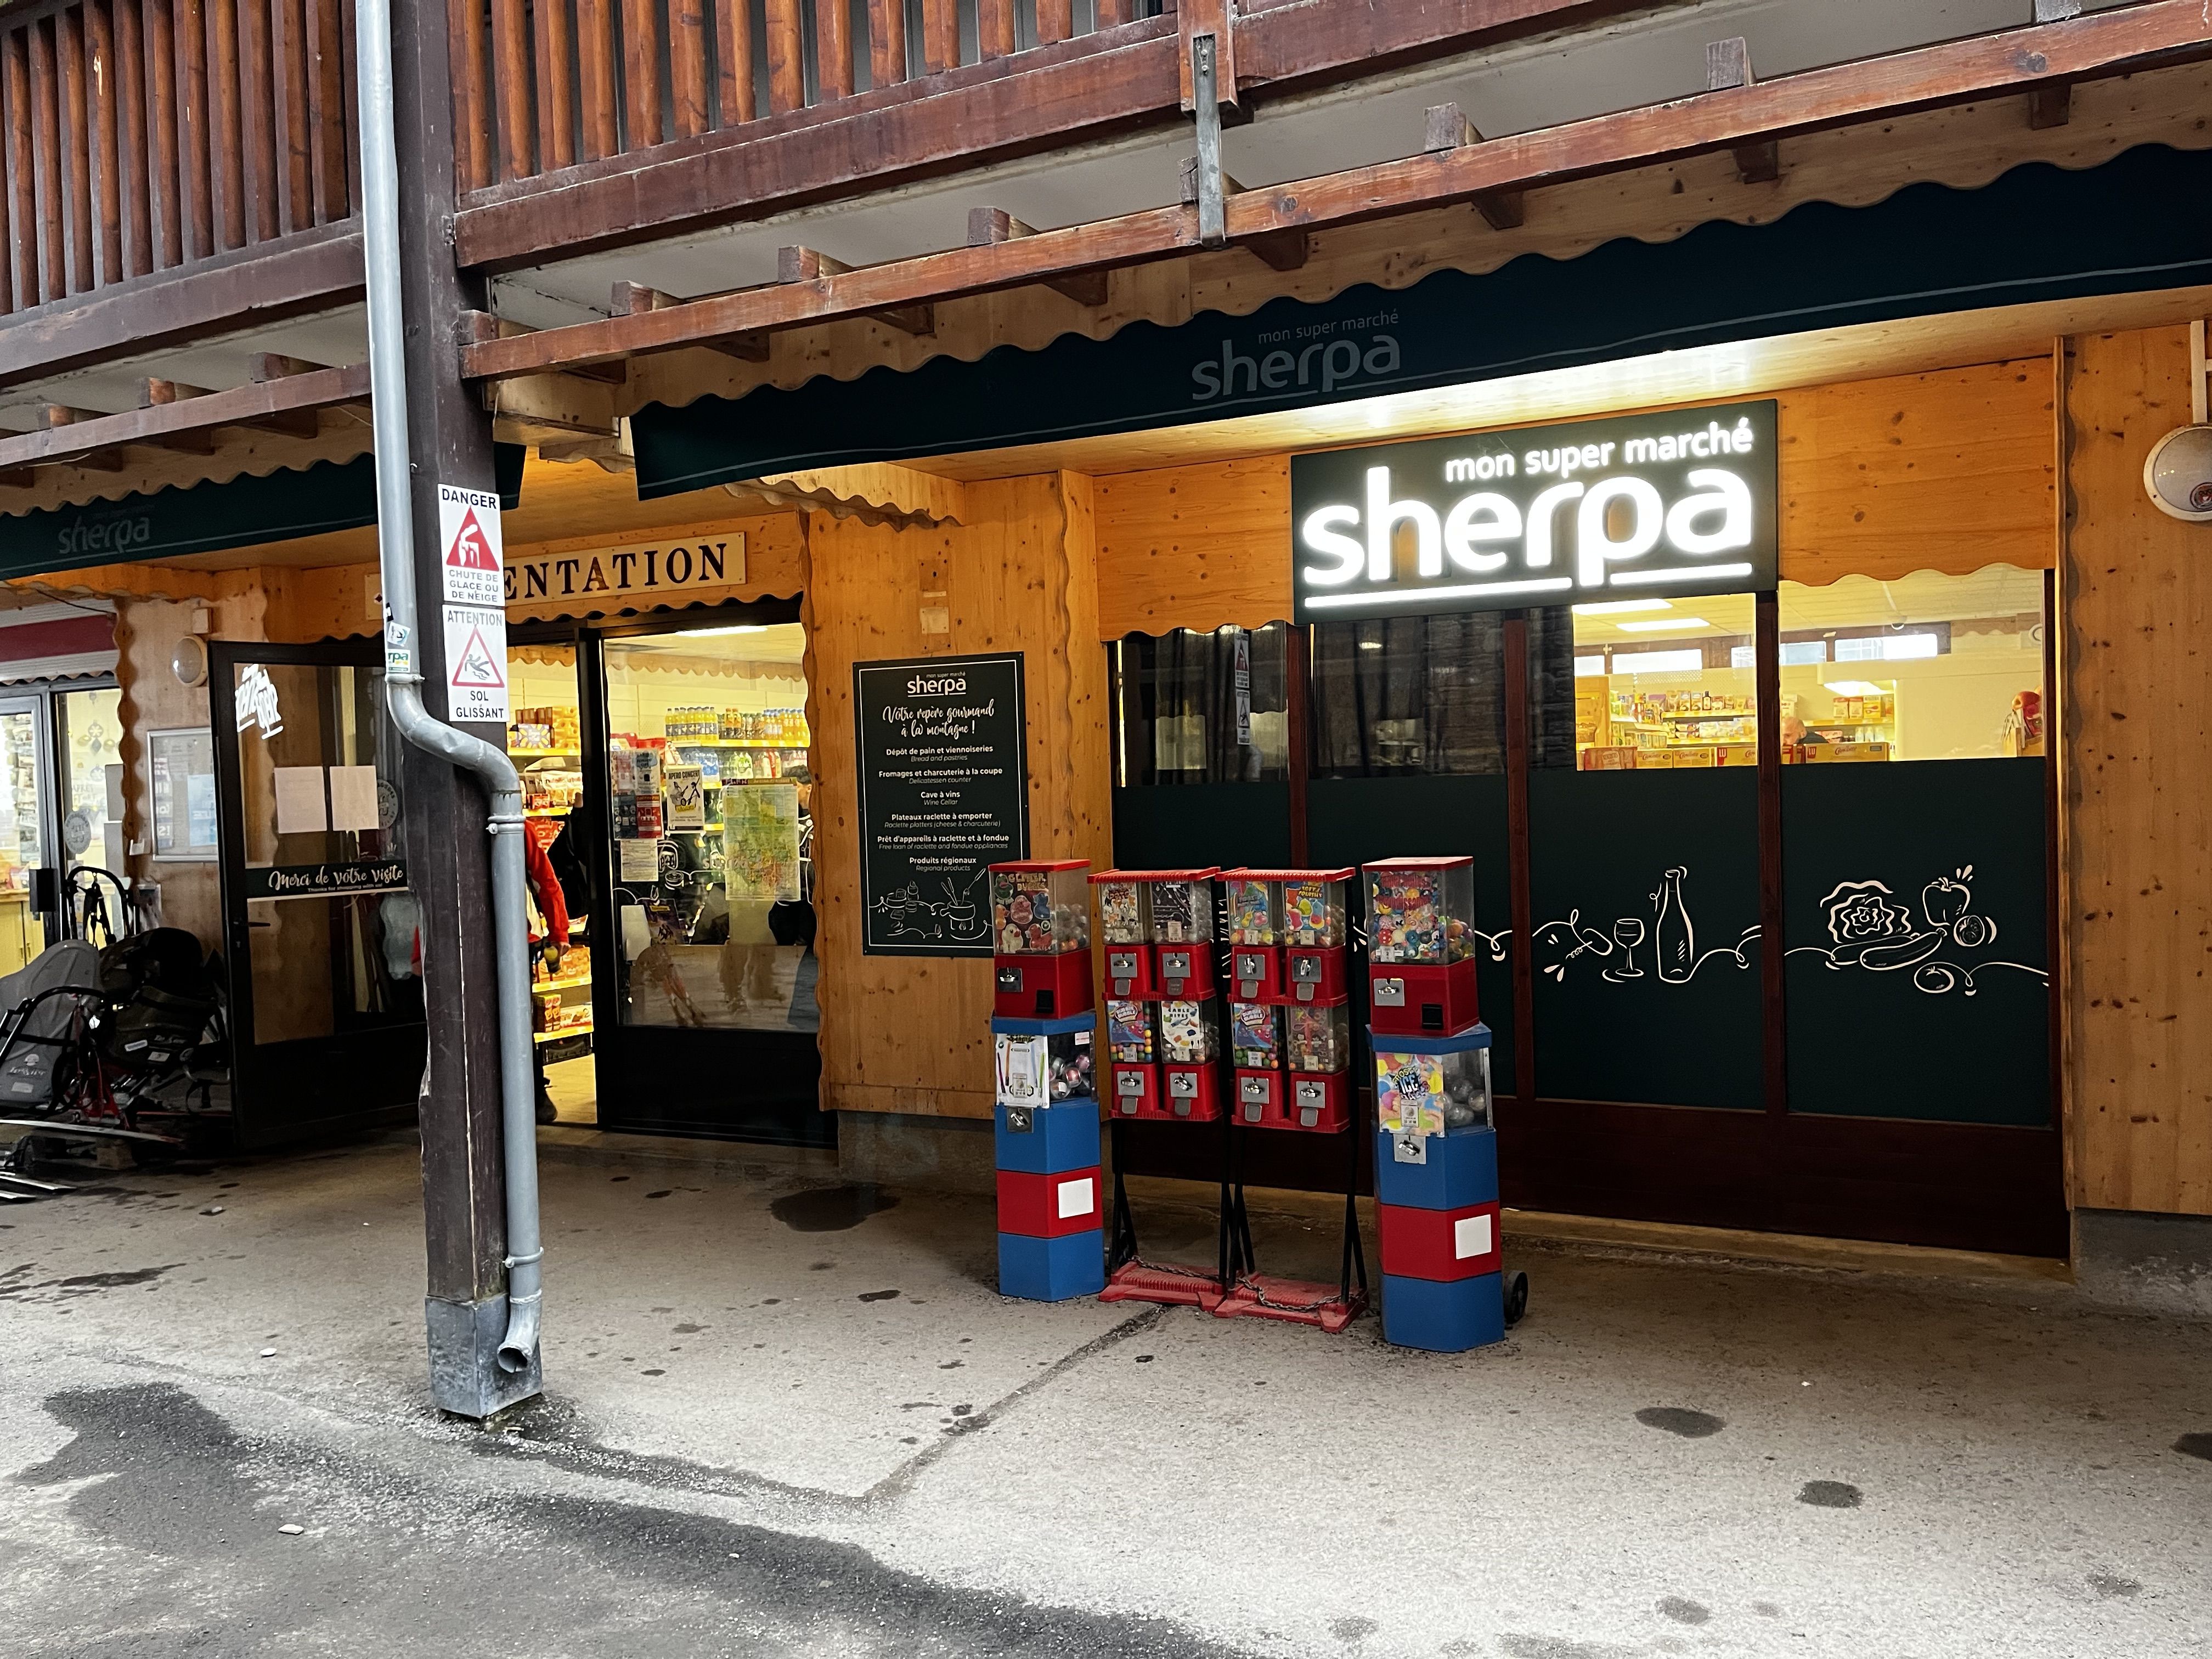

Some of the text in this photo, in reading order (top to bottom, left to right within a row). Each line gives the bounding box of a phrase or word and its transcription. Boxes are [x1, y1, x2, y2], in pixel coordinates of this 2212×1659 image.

[1259, 308, 1398, 343] mon super marché
[1192, 335, 1400, 400] sherpa
[1446, 417, 1753, 482] mon super marché
[442, 488, 496, 509] DANGER
[58, 515, 150, 554] sherpa
[1302, 466, 1753, 586] sherpa
[449, 569, 482, 580] CHUTE
[504, 543, 727, 600] ENTATION
[449, 580, 482, 590] GLACE
[467, 592, 498, 602] NEIGE
[448, 610, 503, 627] ATTENTION
[907, 675, 966, 695] sherpa
[470, 691, 489, 701] SOL
[456, 707, 504, 718] GLISSANT
[882, 698, 994, 723] Votre repère gourmand
[901, 724, 909, 737] à
[911, 719, 923, 737] la
[927, 721, 969, 740] montagne
[886, 748, 907, 757] Dépôt
[919, 747, 935, 755] pain
[945, 744, 994, 753] viennoiseries
[923, 769, 964, 777] charcuterie
[893, 835, 931, 843] d'appareils
[268, 865, 403, 890] Merci de votre visite
[1400, 1075, 1418, 1094] ICE
